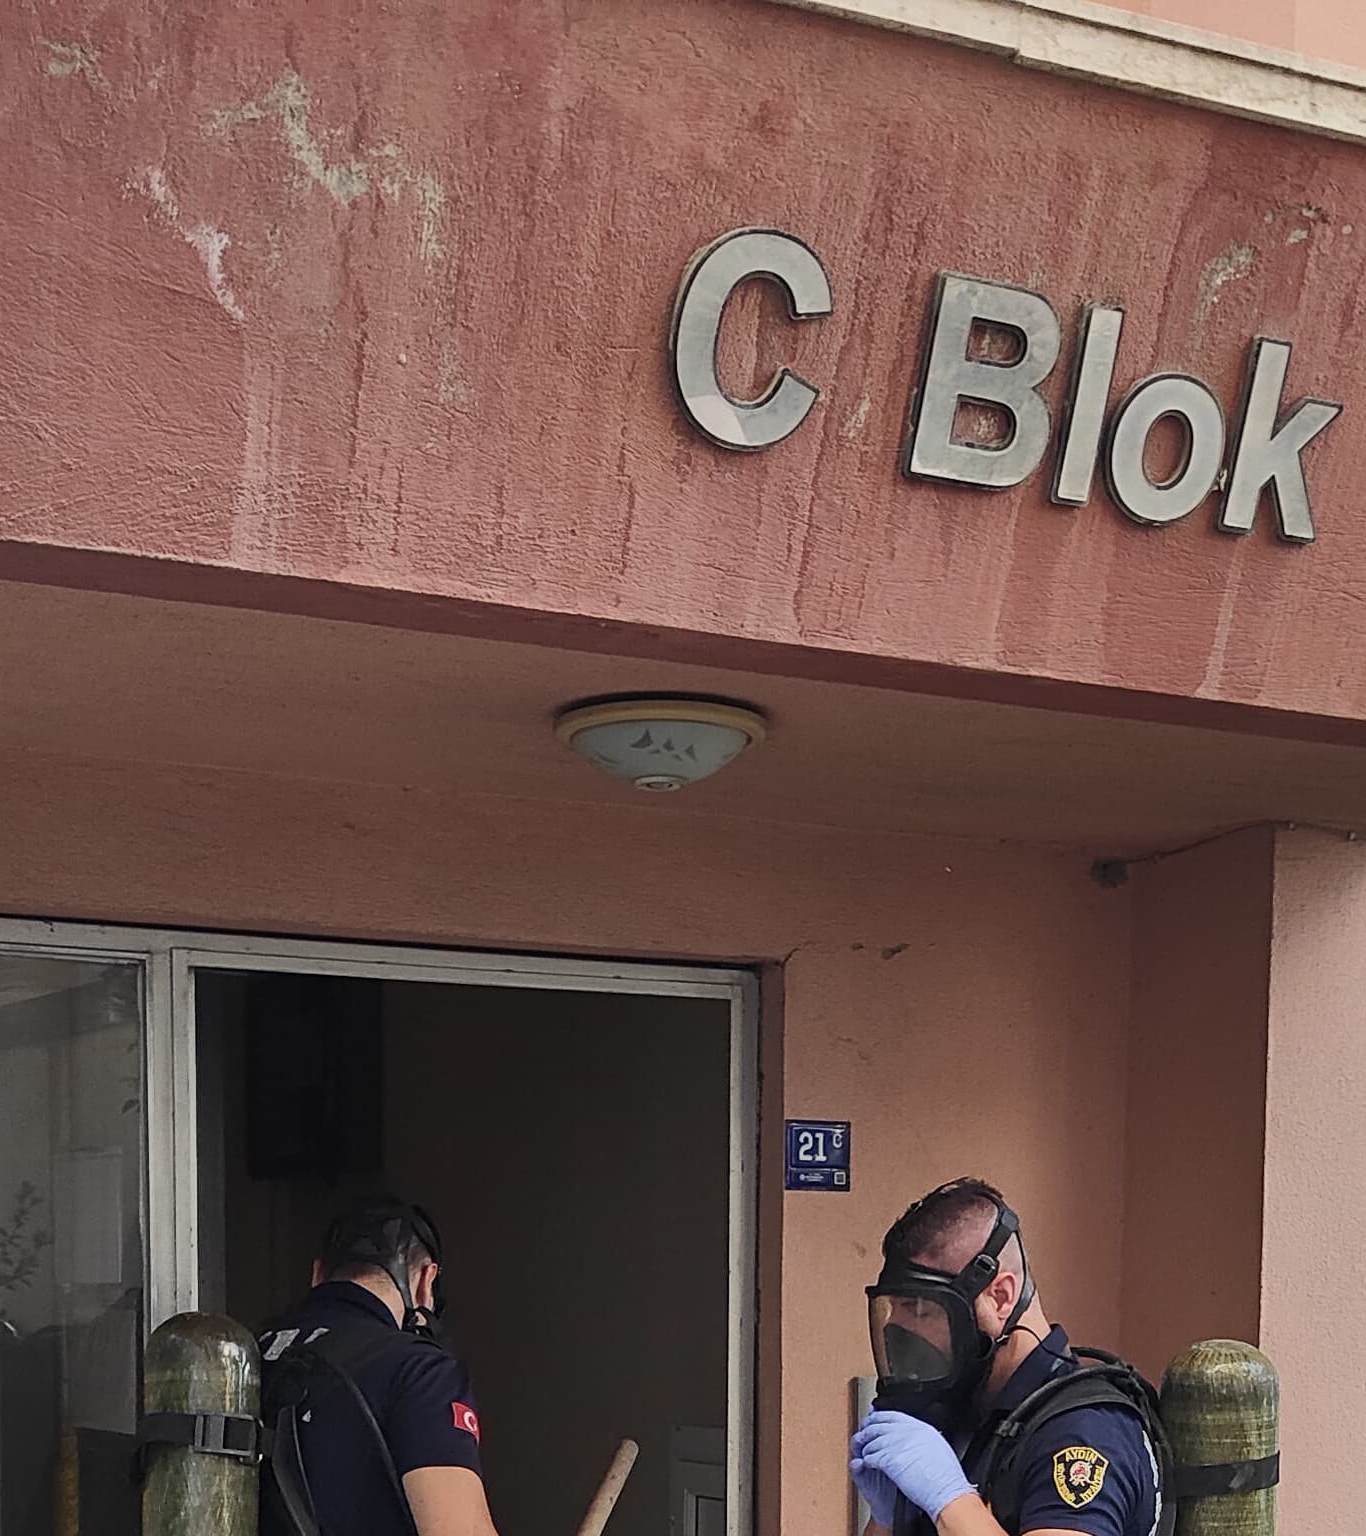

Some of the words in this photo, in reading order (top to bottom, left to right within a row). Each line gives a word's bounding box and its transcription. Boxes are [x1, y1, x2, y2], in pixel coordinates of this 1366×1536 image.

[671, 226, 833, 451] C
[902, 269, 1343, 544] Blok
[798, 1131, 827, 1161] 21
